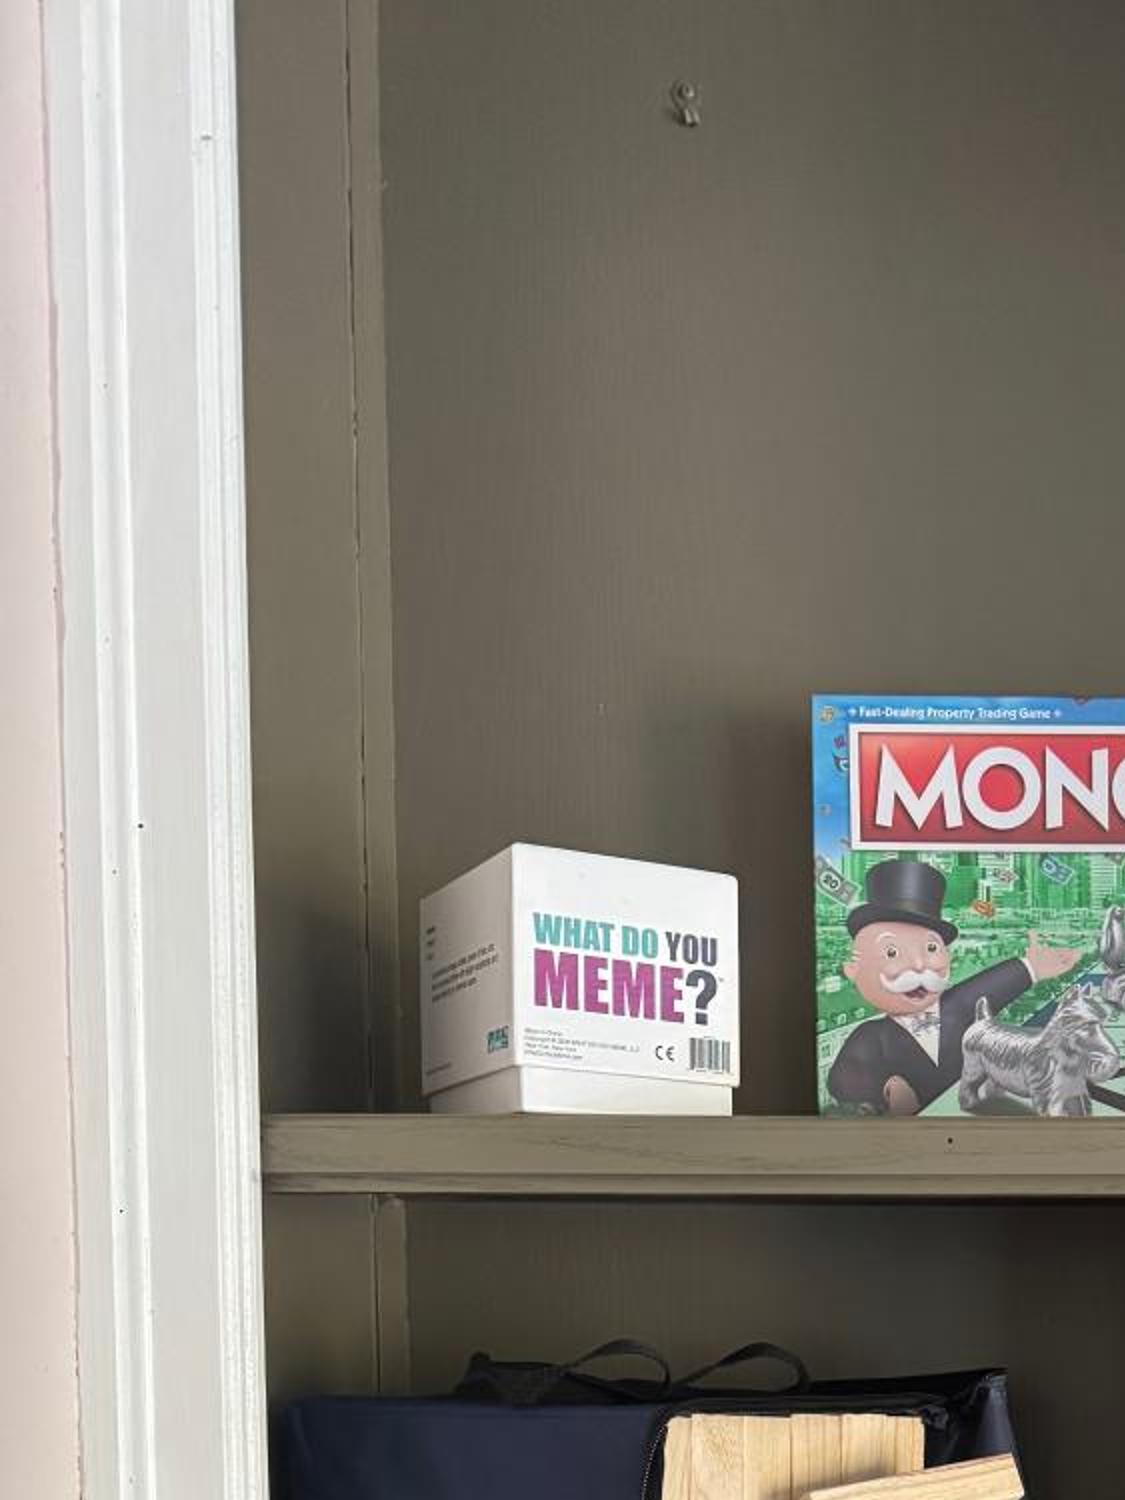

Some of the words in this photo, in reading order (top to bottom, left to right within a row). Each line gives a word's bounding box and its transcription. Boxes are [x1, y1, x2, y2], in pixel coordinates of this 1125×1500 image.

[860, 707, 924, 719] Fast-Dealing
[927, 708, 975, 721] Property
[978, 708, 1017, 720] Trading
[1019, 708, 1051, 719] Game
[533, 912, 616, 953] WHAT
[621, 926, 658, 958] DO
[666, 931, 718, 967] YOU
[533, 948, 718, 1026] MEME?
